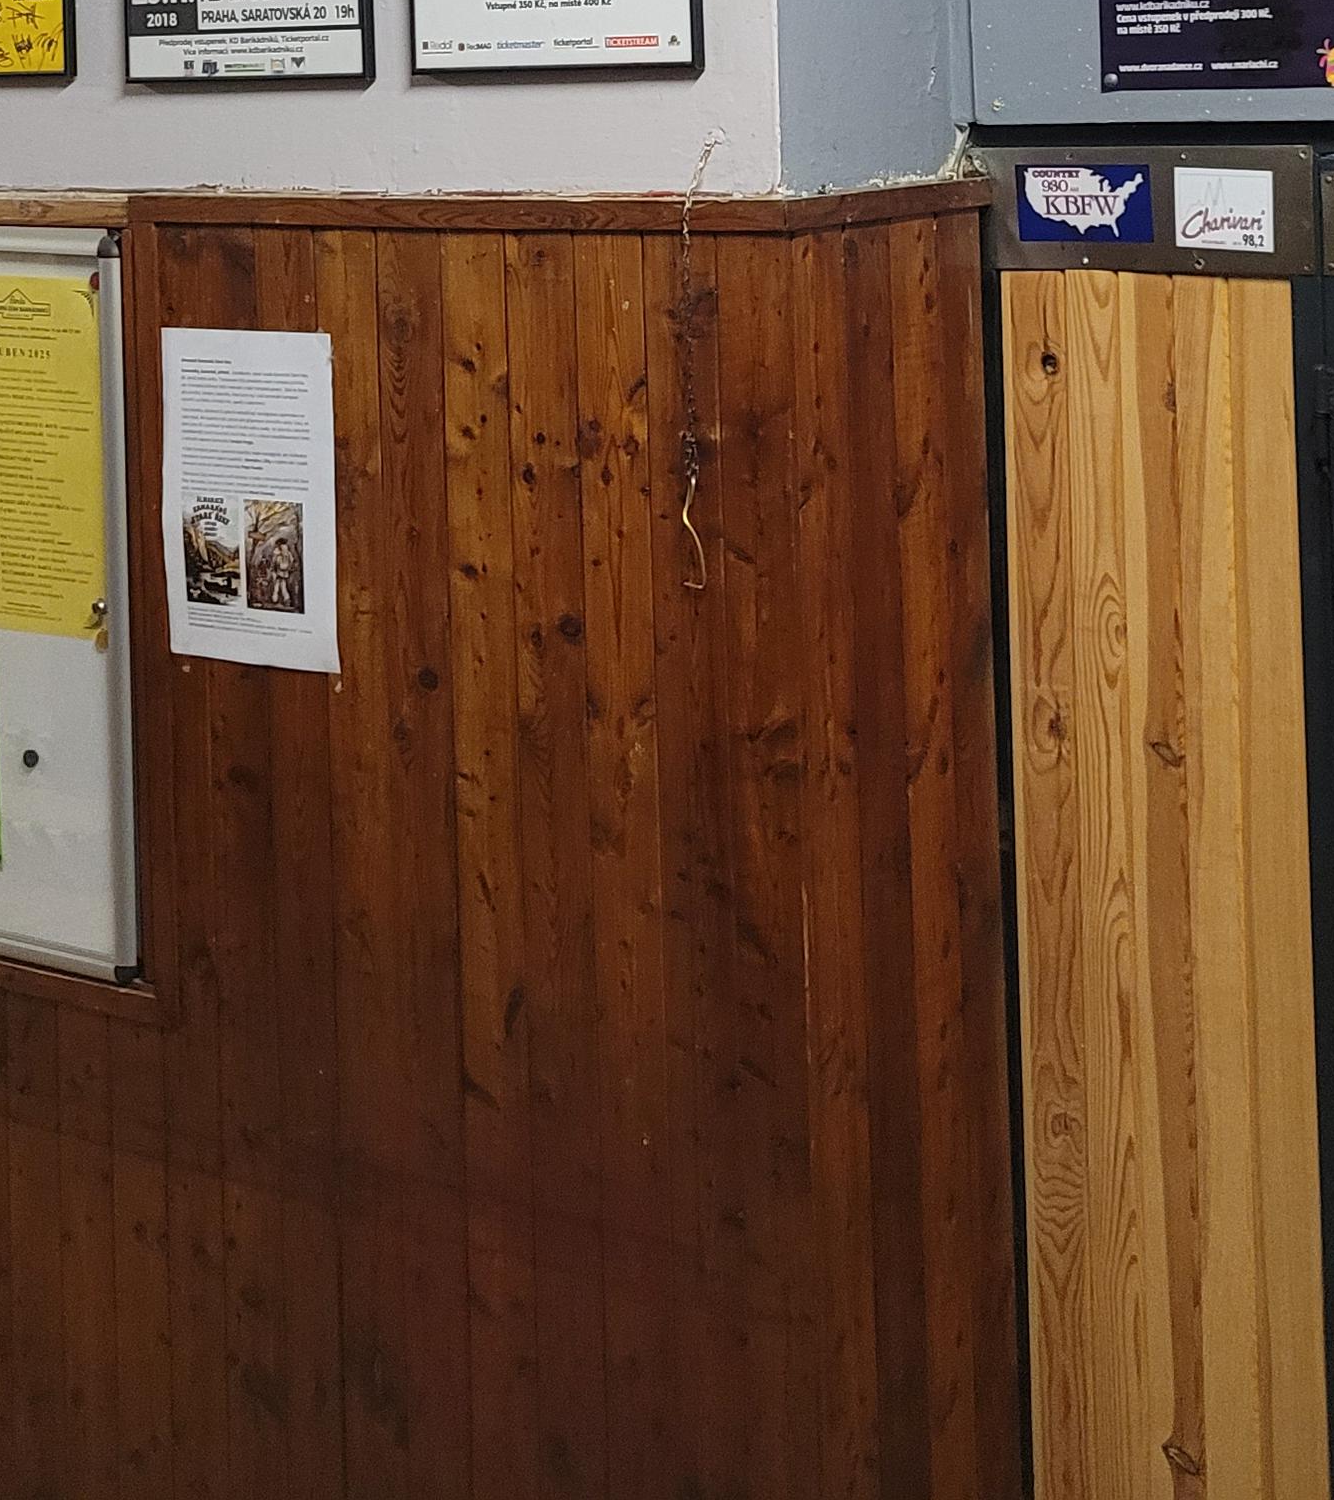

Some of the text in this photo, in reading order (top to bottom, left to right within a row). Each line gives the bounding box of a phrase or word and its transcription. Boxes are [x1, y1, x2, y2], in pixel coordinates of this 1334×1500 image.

[241, 3, 311, 21] SARATOVSKÁ
[313, 6, 327, 20] 20
[334, 6, 355, 19] 19h
[147, 13, 178, 28] 2018
[1032, 170, 1080, 178] COUNTRY
[1041, 180, 1068, 192] 930
[1042, 195, 1120, 216] KBFW
[1181, 208, 1266, 239] Charivari
[1242, 234, 1265, 248] 98,2
